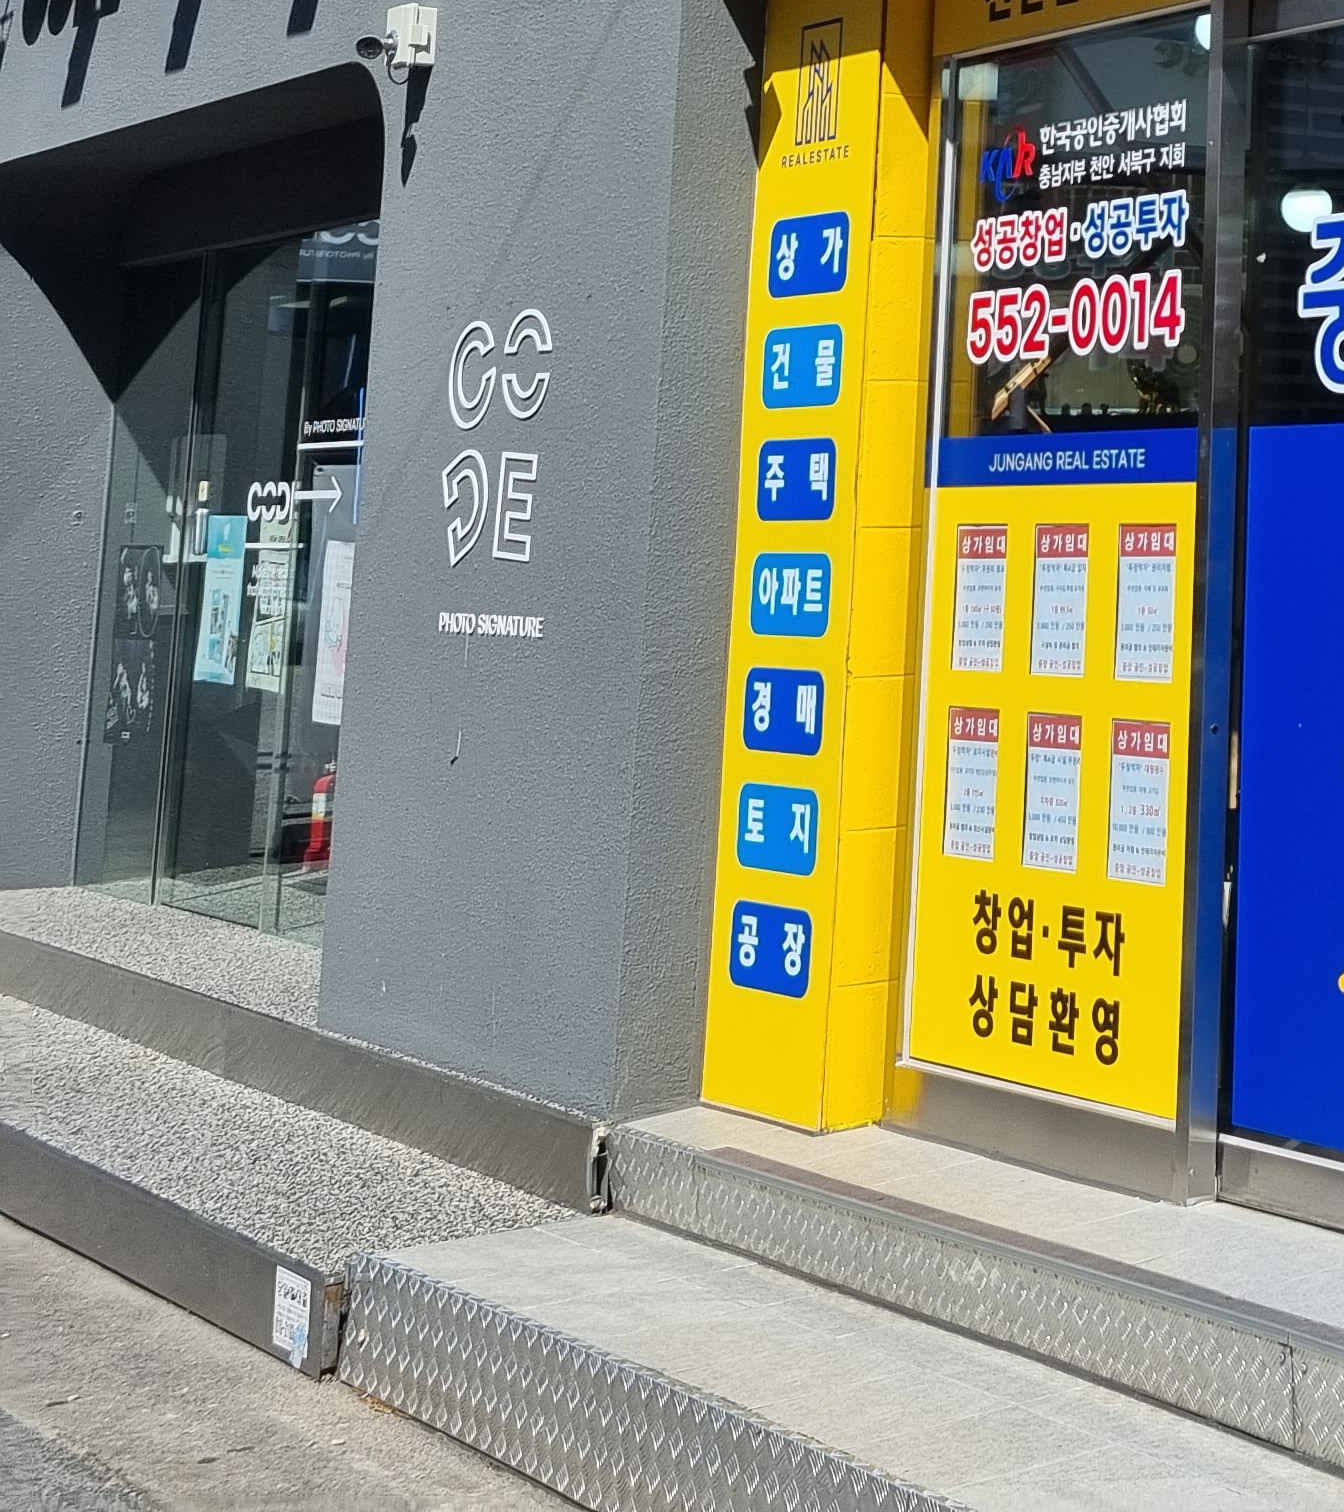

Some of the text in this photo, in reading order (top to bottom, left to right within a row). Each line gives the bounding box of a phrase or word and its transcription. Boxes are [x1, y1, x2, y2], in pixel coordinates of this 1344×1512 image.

[1039, 99, 1187, 155] 한국공인중개사협회
[1039, 141, 1186, 189] 충남지부 천안 서북구 지회
[967, 269, 1186, 365] 552-0014
[313, 420, 334, 433] PHOTO
[989, 449, 1145, 472] JUNGANG REAL ESTATE
[962, 535, 1006, 553] 상가임대
[1041, 533, 1087, 553] 상가임대
[1125, 532, 1174, 552] 상가임대
[758, 567, 823, 615] 아파트
[438, 611, 544, 638] PHOTO SIGNATURE
[954, 717, 998, 737] 상가임대
[1032, 723, 1079, 745] 상가임대
[1117, 731, 1168, 753] 상가임대
[968, 974, 1120, 1066] 상담환영
